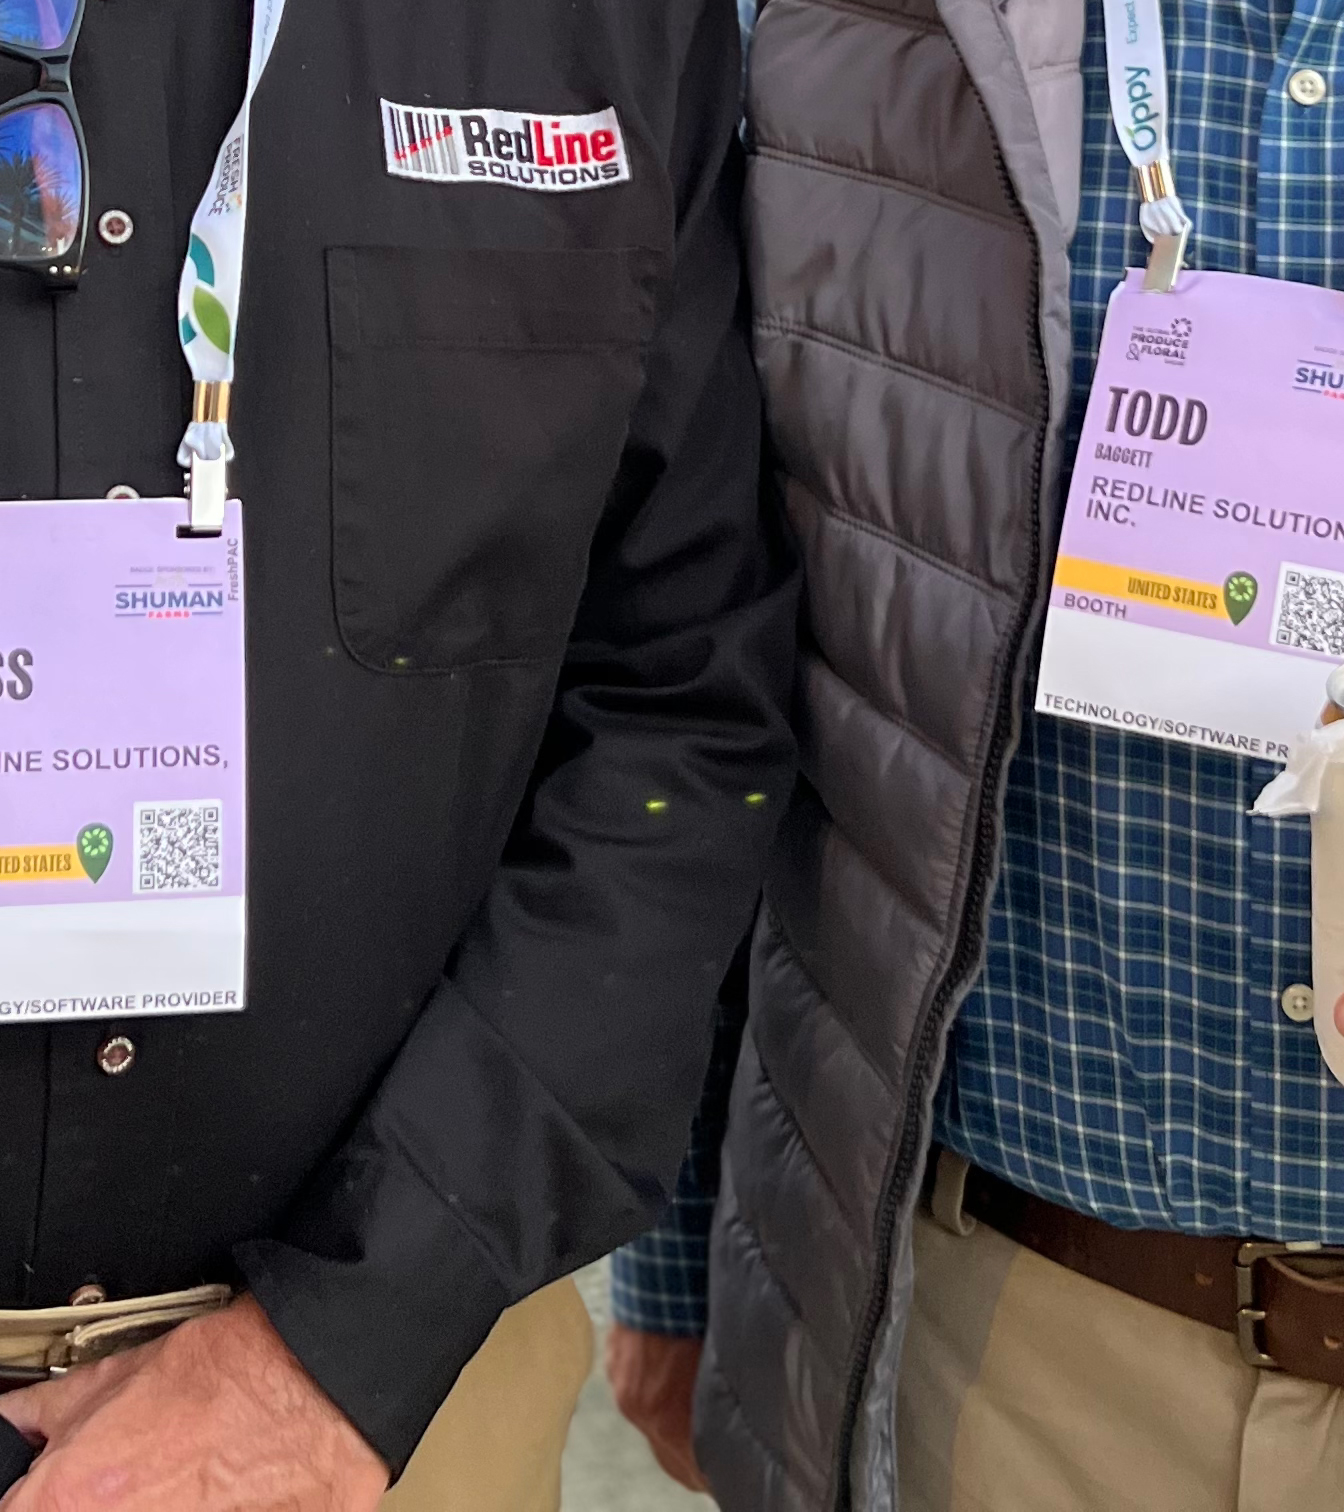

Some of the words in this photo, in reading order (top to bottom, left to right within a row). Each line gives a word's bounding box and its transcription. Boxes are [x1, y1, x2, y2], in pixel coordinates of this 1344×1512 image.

[1124, 1, 1139, 45] Expect
[1124, 66, 1160, 151] Oppy
[460, 115, 617, 167] RedLine
[208, 143, 232, 216] PRODUCE
[228, 137, 241, 193] FRESH
[468, 160, 620, 185] SOLUTIONS
[1131, 333, 1188, 348] PRODUCE
[1140, 345, 1186, 359] FLORAL
[1105, 385, 1207, 446] TODD
[1095, 443, 1153, 469] BAGGETT
[1091, 476, 1207, 515] REDLINE
[1086, 499, 1136, 527] INC.
[227, 538, 239, 601] FreshPAC
[115, 590, 223, 609] SHUMAN
[1064, 592, 1127, 619] BOOTH
[1128, 577, 1171, 601] UNITED
[1173, 585, 1218, 610] STATES
[1044, 693, 1261, 752] TECHNOLOGY/SOFTWARE
[52, 744, 229, 771] SOLUTIONS,
[23, 853, 72, 873] STATES
[142, 990, 238, 1009] PROVIDER
